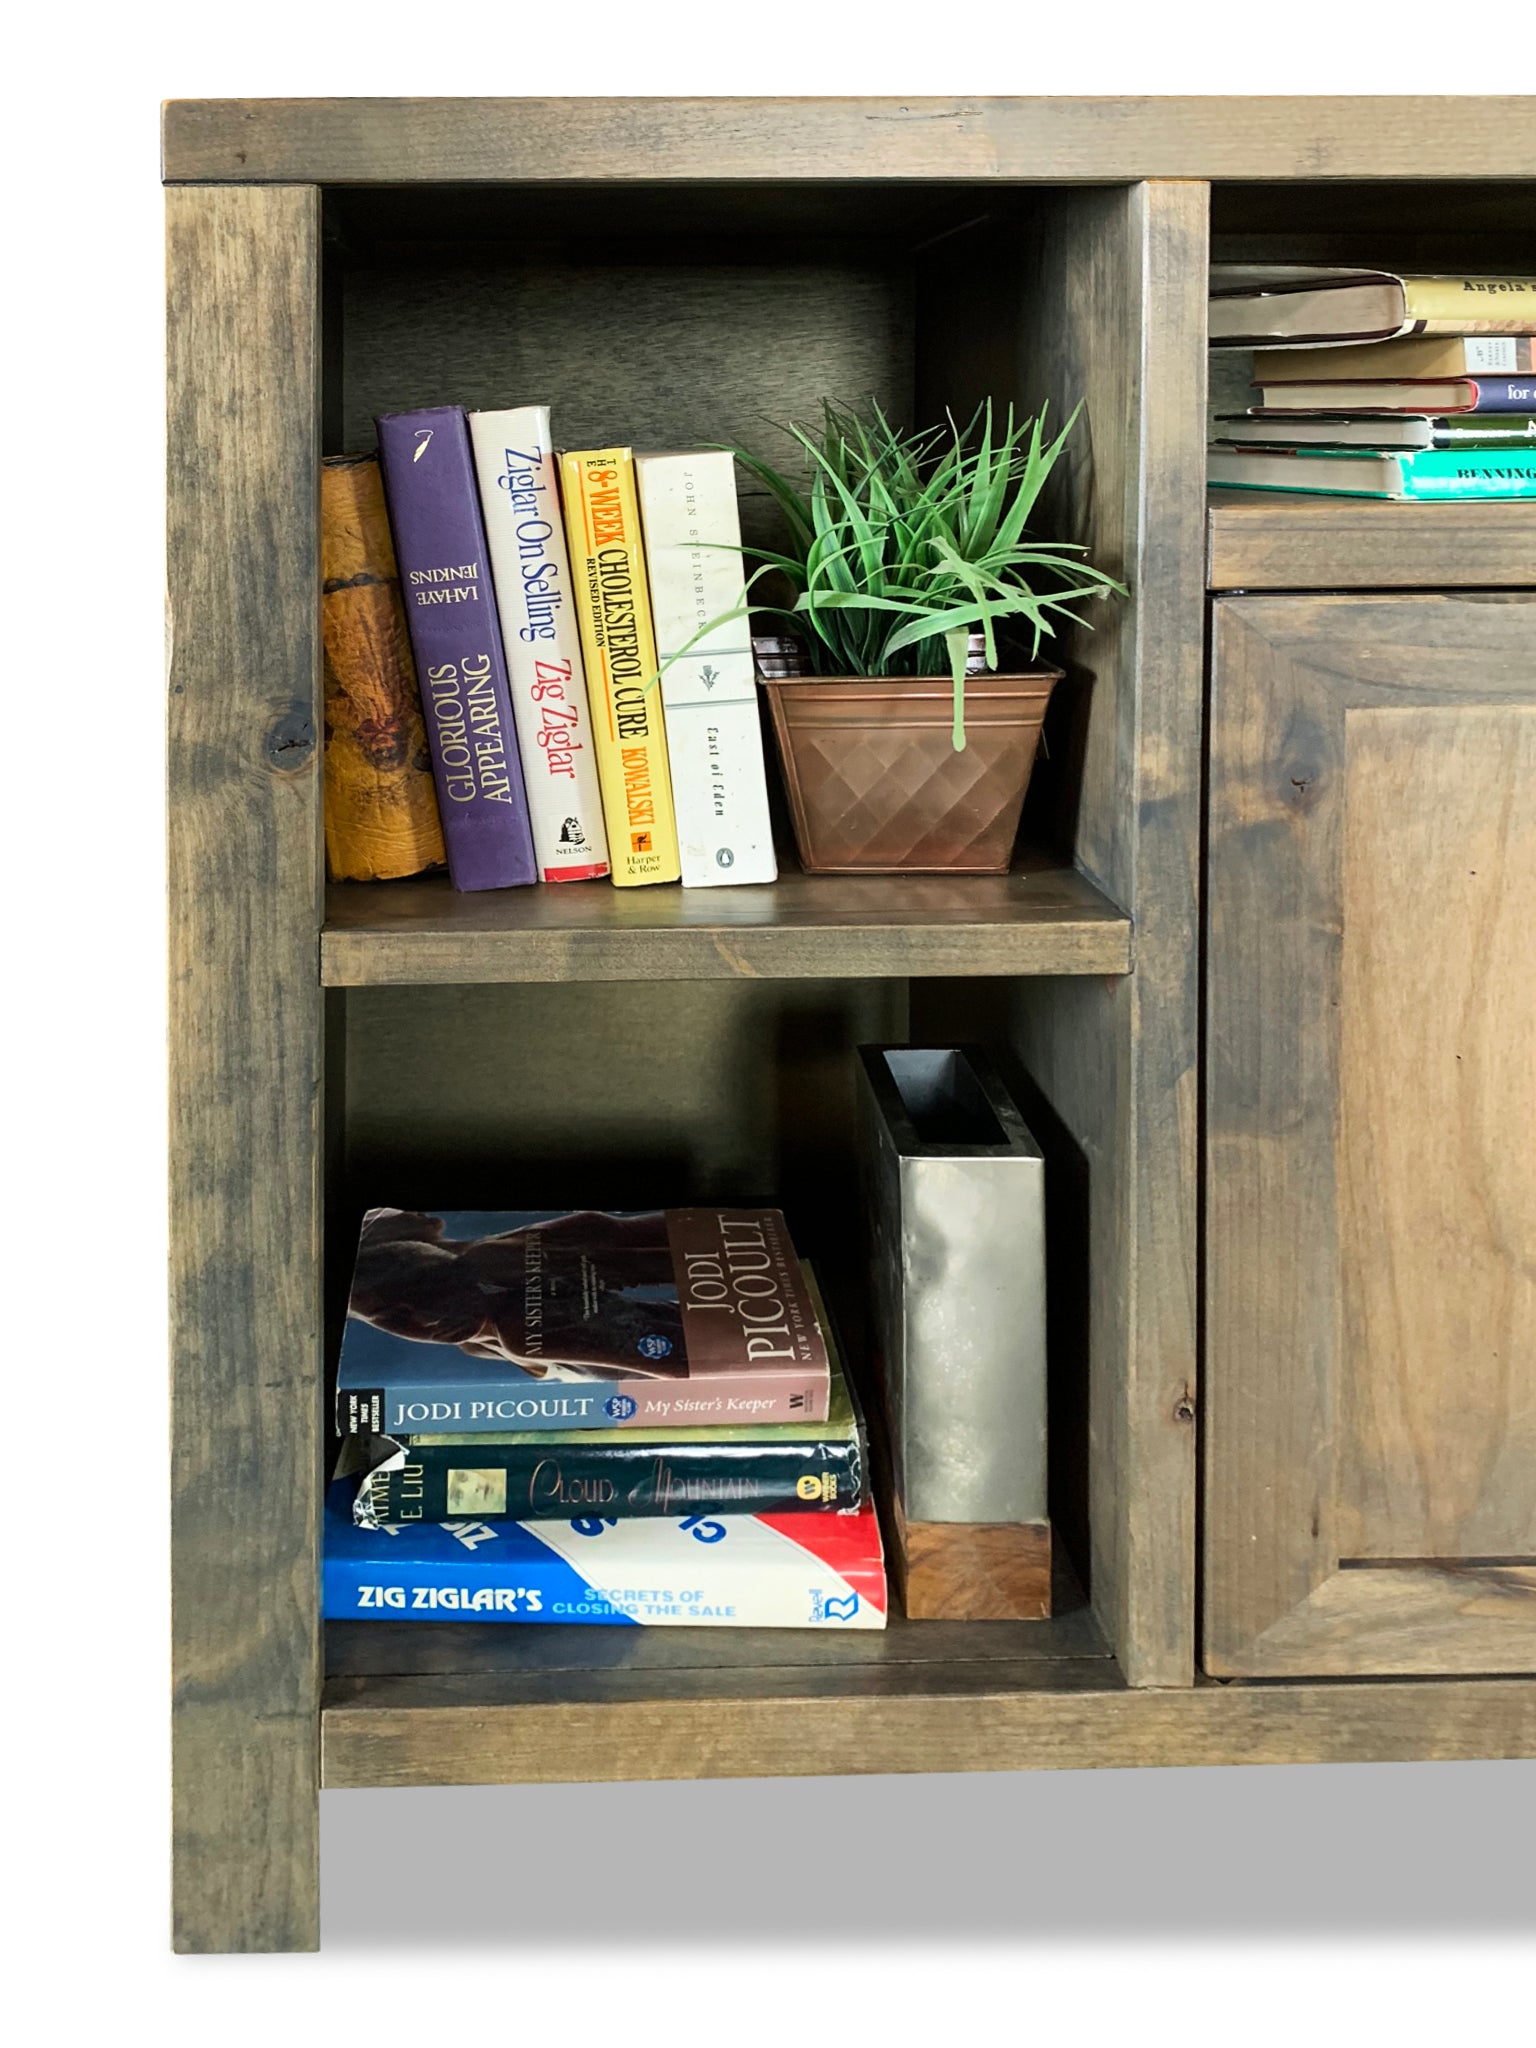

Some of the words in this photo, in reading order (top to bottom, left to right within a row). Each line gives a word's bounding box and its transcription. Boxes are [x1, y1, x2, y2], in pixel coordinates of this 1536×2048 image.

[1507, 384, 1530, 400] for
[587, 458, 616, 468] THE
[498, 446, 547, 517] Ziglar
[684, 472, 697, 516] JOHN
[587, 470, 626, 547] 8-WEEK
[516, 520, 553, 560] On
[409, 562, 479, 585] JENKINS
[586, 558, 600, 602] REVISED
[416, 585, 479, 606] LAHAYE
[520, 563, 563, 643] Selling
[592, 605, 606, 647] EDITION
[598, 549, 643, 685] CHOLESTEROL
[530, 659, 573, 702] Zig
[614, 687, 649, 740] CURE
[428, 664, 476, 803] GLORIOUS
[461, 654, 512, 804] APPEARING
[537, 705, 584, 779] Ziglar
[707, 727, 720, 756] East
[711, 764, 724, 776] of
[621, 746, 655, 827] KOWALSKI
[713, 784, 725, 816] Eden
[555, 846, 592, 856] NELSON
[626, 855, 661, 866] Harper
[627, 866, 637, 875] &
[639, 865, 661, 874] Row
[684, 1251, 735, 1314] JODI
[717, 1214, 796, 1361] PICOULT
[788, 1301, 805, 1329] YORK
[525, 1331, 543, 1355] MY
[797, 1334, 813, 1361] NEW
[350, 1395, 358, 1414] YORK
[361, 1403, 369, 1423] TIMES
[371, 1395, 380, 1432] BESTSELLER
[394, 1402, 462, 1426] JODI
[470, 1398, 594, 1419] PICOULT
[612, 1397, 621, 1417] WSP
[645, 1399, 671, 1416] My
[673, 1397, 723, 1412] Sister's
[727, 1397, 776, 1412] Keeper
[350, 1415, 358, 1433] NEW
[401, 1464, 424, 1498] LIU
[358, 1586, 406, 1609] ZIG
[412, 1587, 543, 1612] ZIGLAR'S
[584, 1588, 673, 1602] SECRETS
[679, 1590, 705, 1602] OF
[552, 1602, 639, 1615] CLOSING
[644, 1604, 682, 1615] THE
[689, 1605, 736, 1617] SALE
